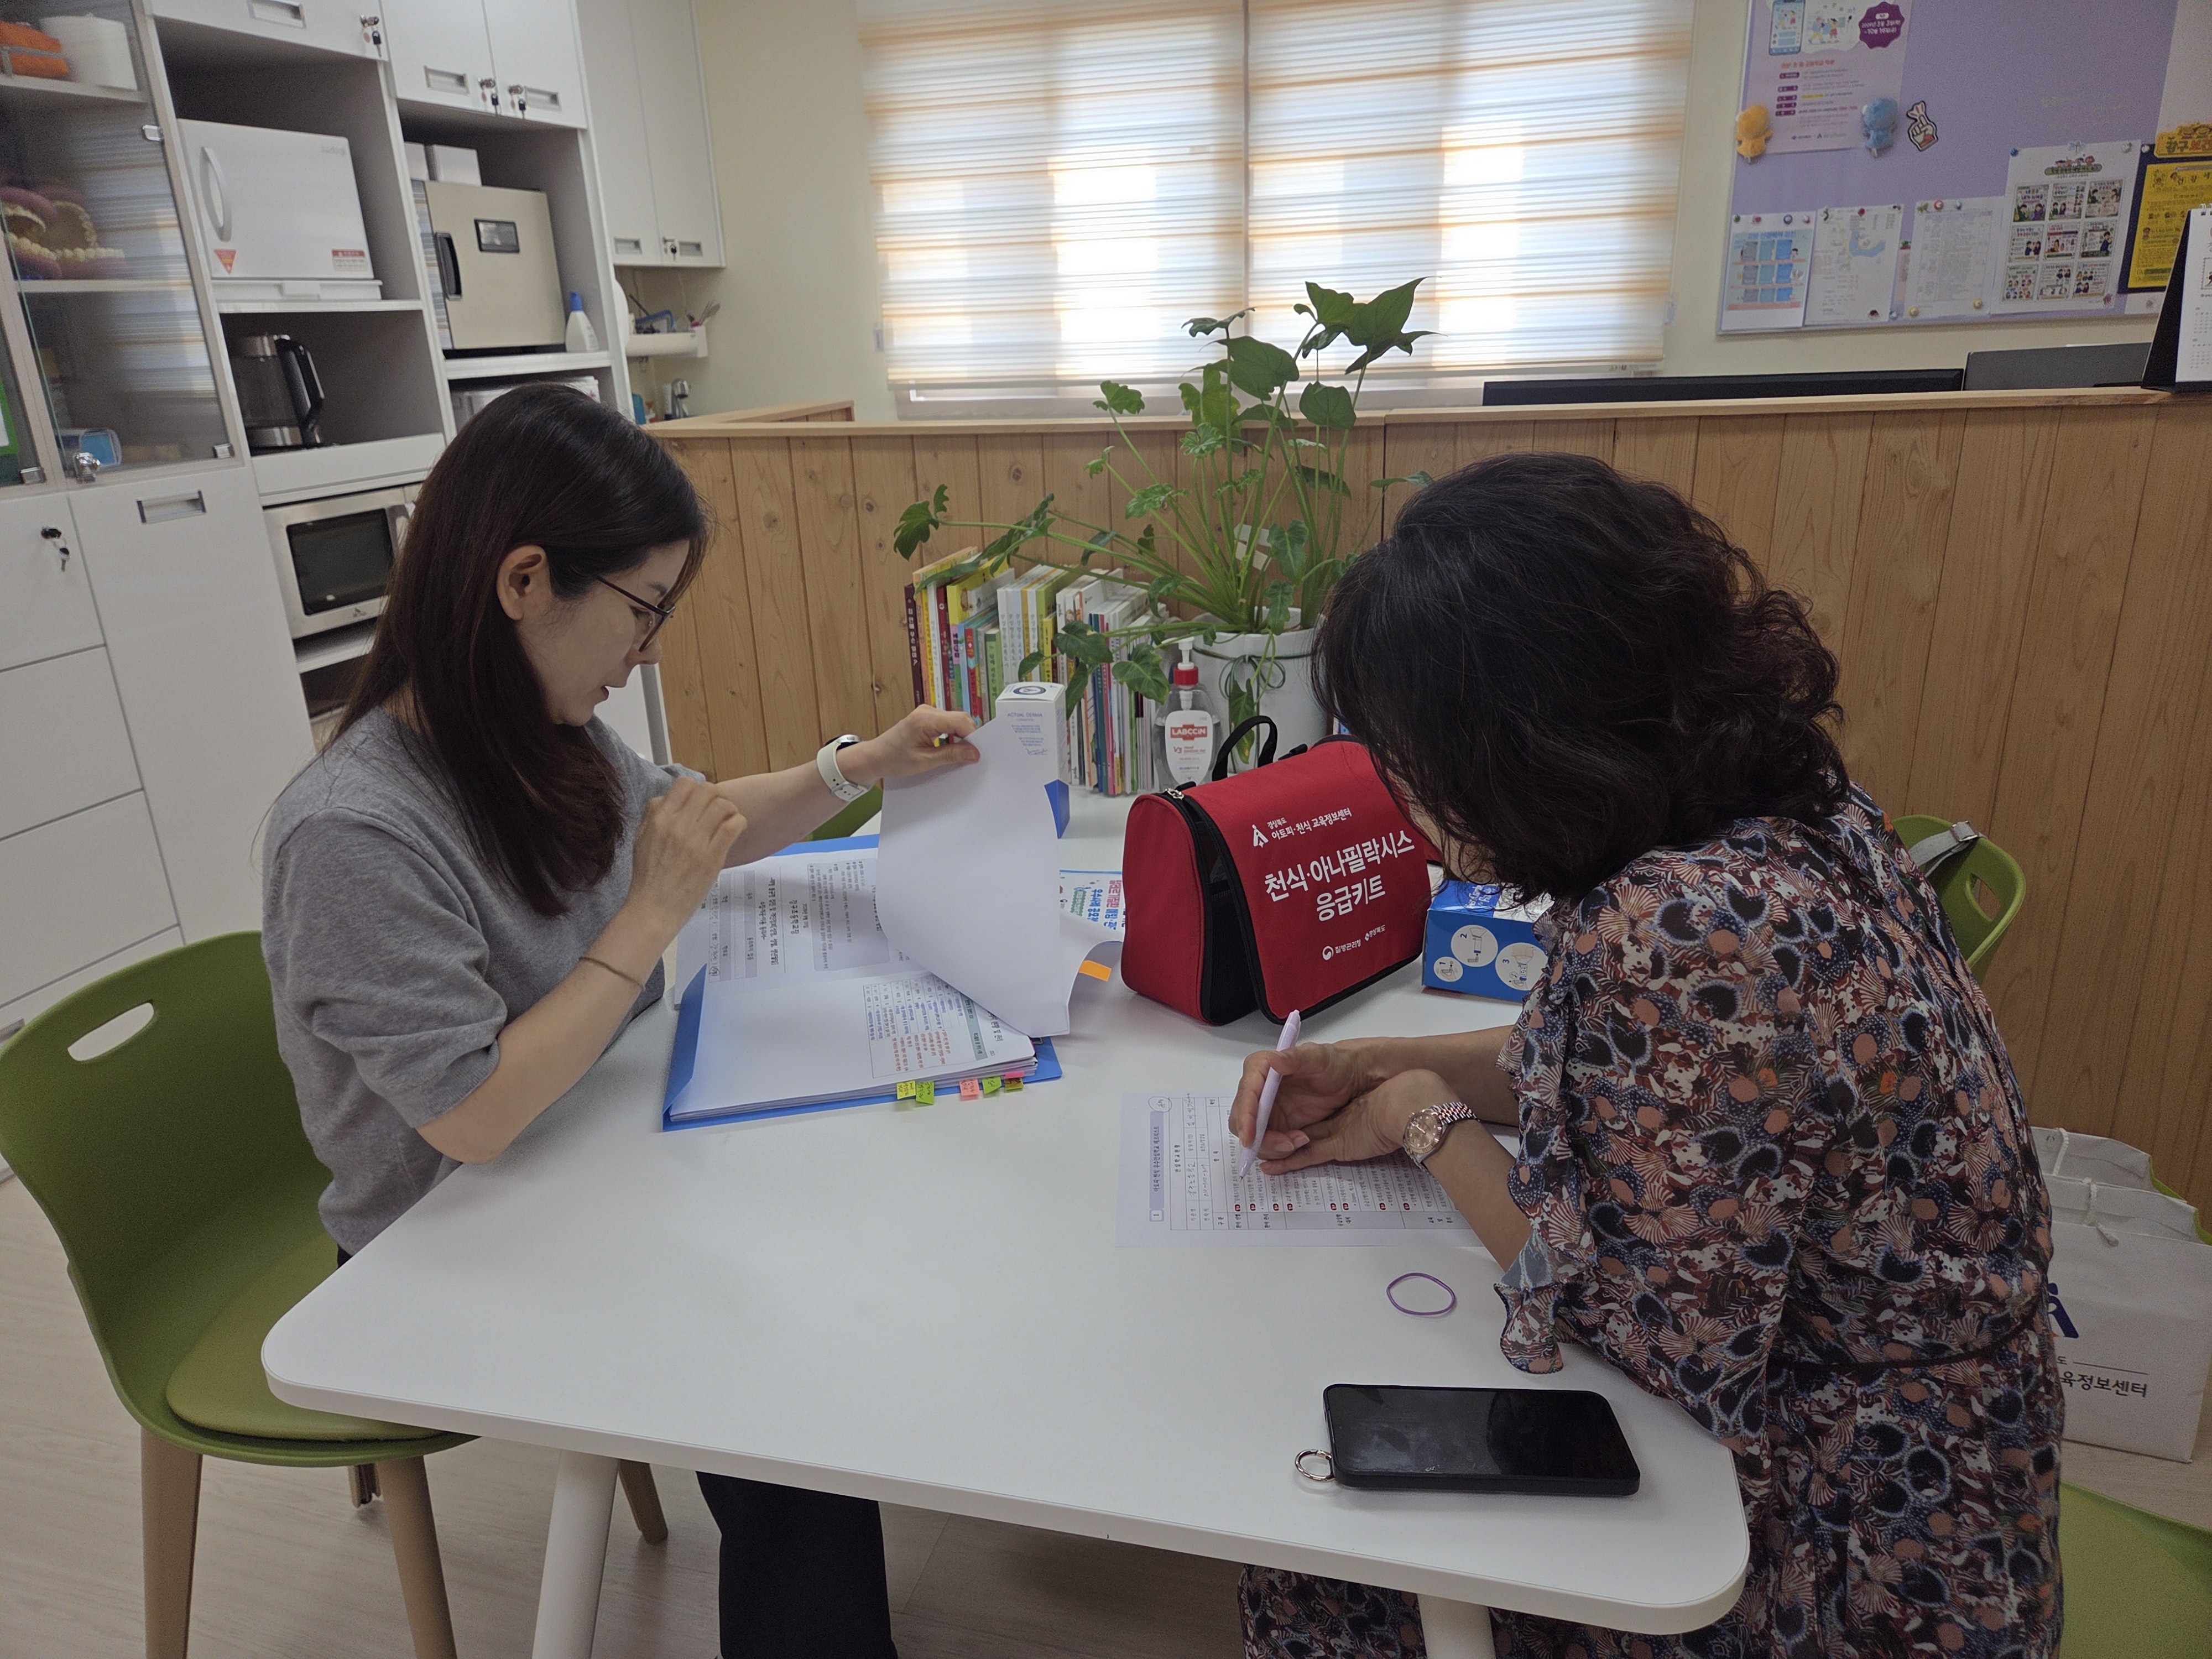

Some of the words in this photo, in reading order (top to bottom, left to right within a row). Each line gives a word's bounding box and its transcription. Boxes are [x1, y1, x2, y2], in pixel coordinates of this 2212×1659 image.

[1267, 817, 1287, 830] 경상북도
[1271, 821, 1312, 839] 아토피·천식
[1311, 807, 1352, 828] 교육정보센터
[1264, 830, 1415, 902] 천식·아나필락시스
[1315, 875, 1386, 922] 응급키트
[789, 900, 799, 934] 강구초등학교장
[1335, 939, 1361, 953] 질병관리청
[2059, 1371, 2148, 1398] 육정보센터
